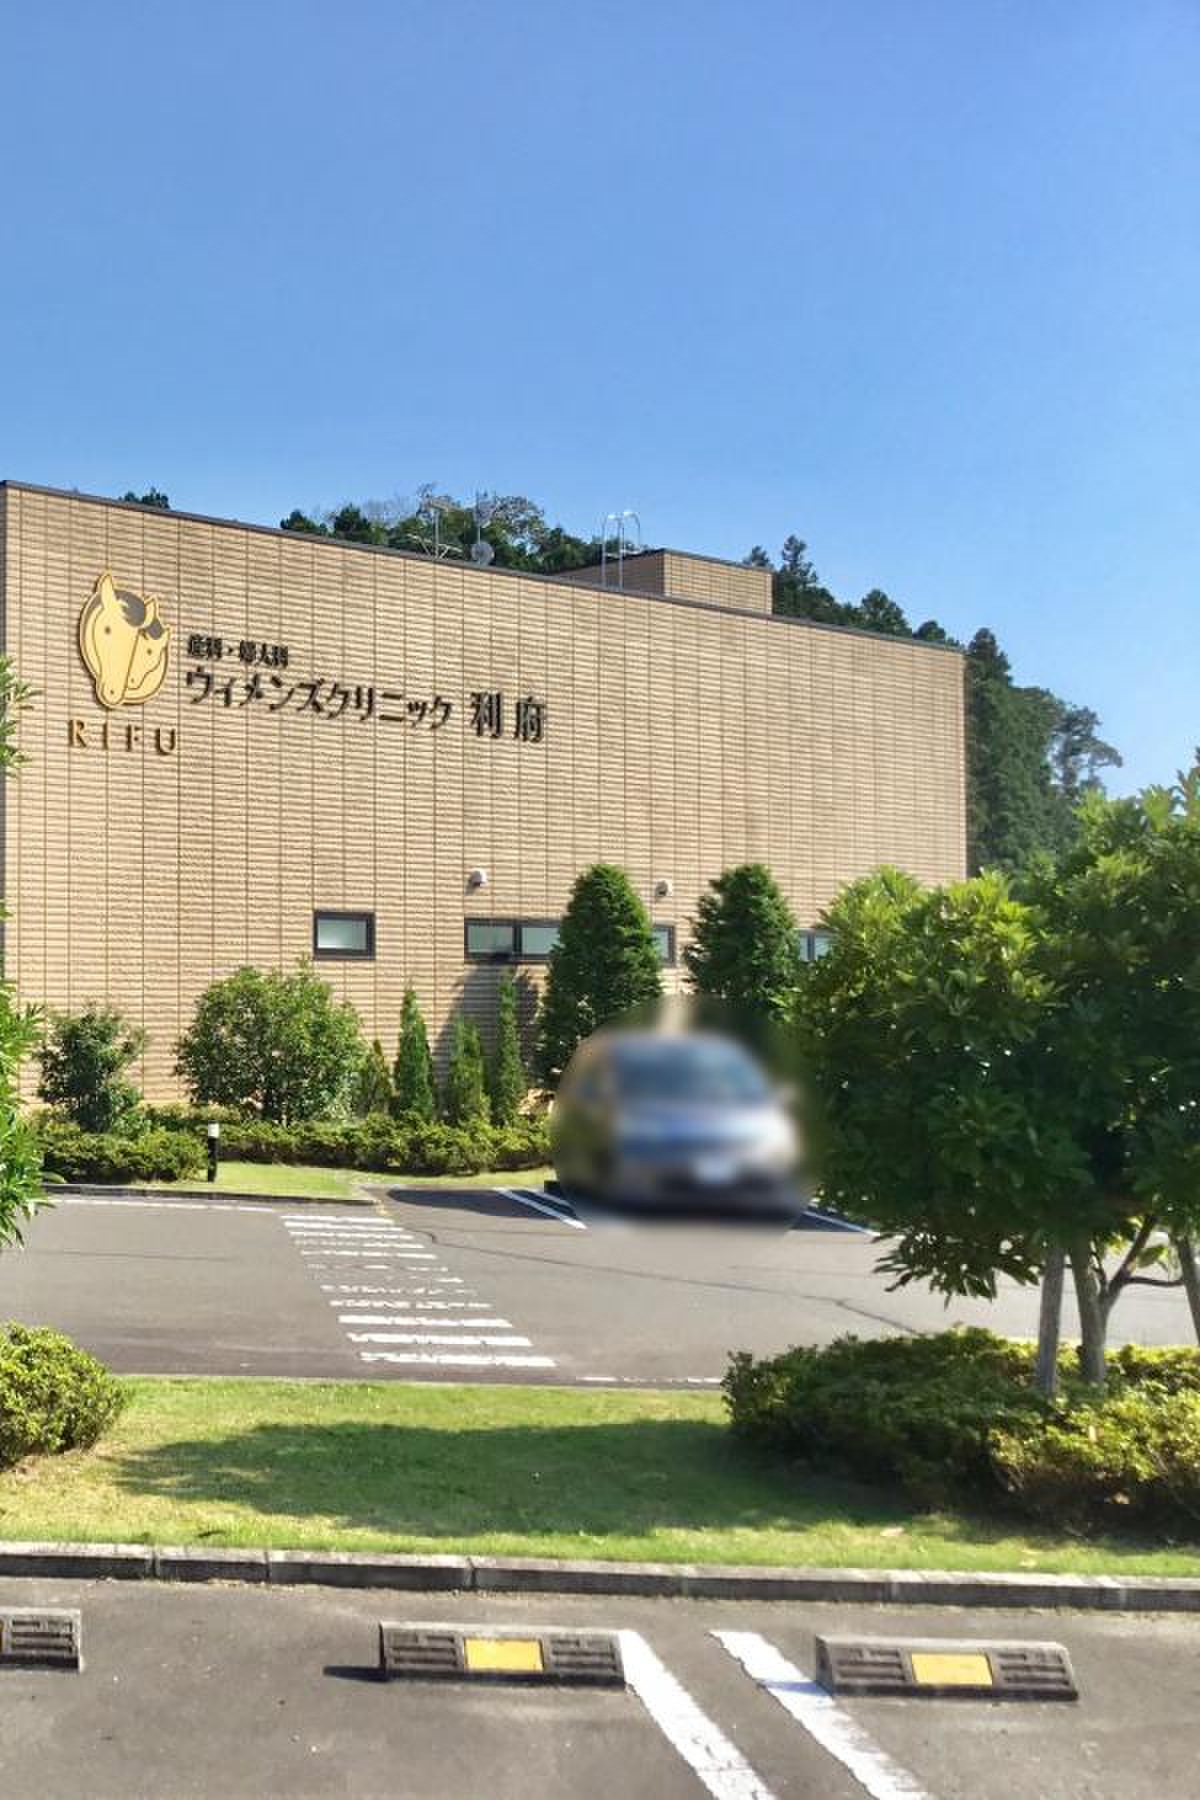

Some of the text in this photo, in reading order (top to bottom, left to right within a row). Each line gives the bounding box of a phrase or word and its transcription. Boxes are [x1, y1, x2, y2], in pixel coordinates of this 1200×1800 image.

[186, 665, 547, 744] ウィメンズクリニック 利府
[67, 718, 177, 757] RIFU
